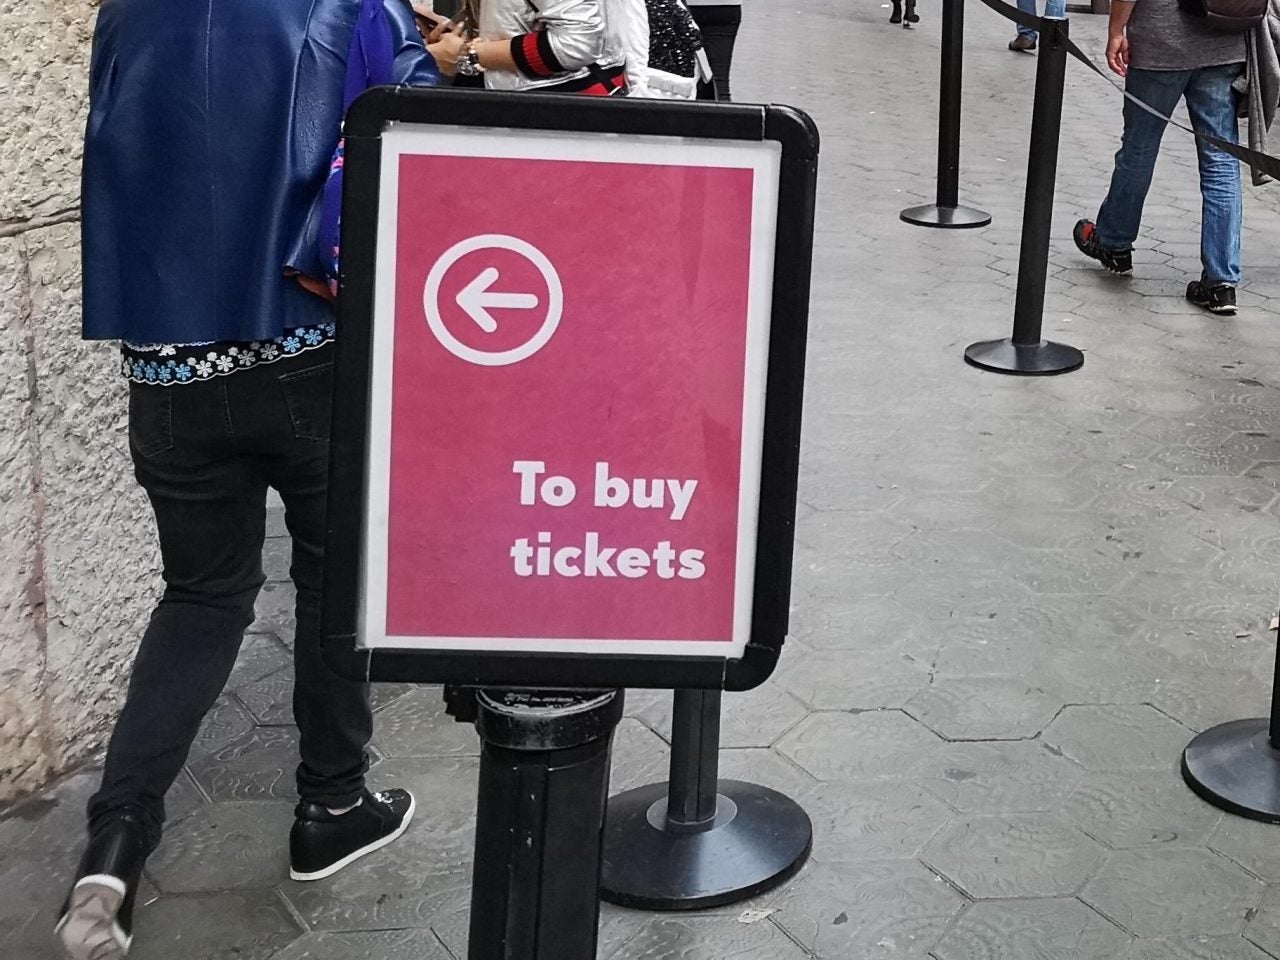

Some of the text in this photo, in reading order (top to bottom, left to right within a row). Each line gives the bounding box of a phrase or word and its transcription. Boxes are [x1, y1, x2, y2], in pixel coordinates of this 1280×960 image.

[512, 460, 698, 520] To buy
[510, 531, 706, 579] tickets
